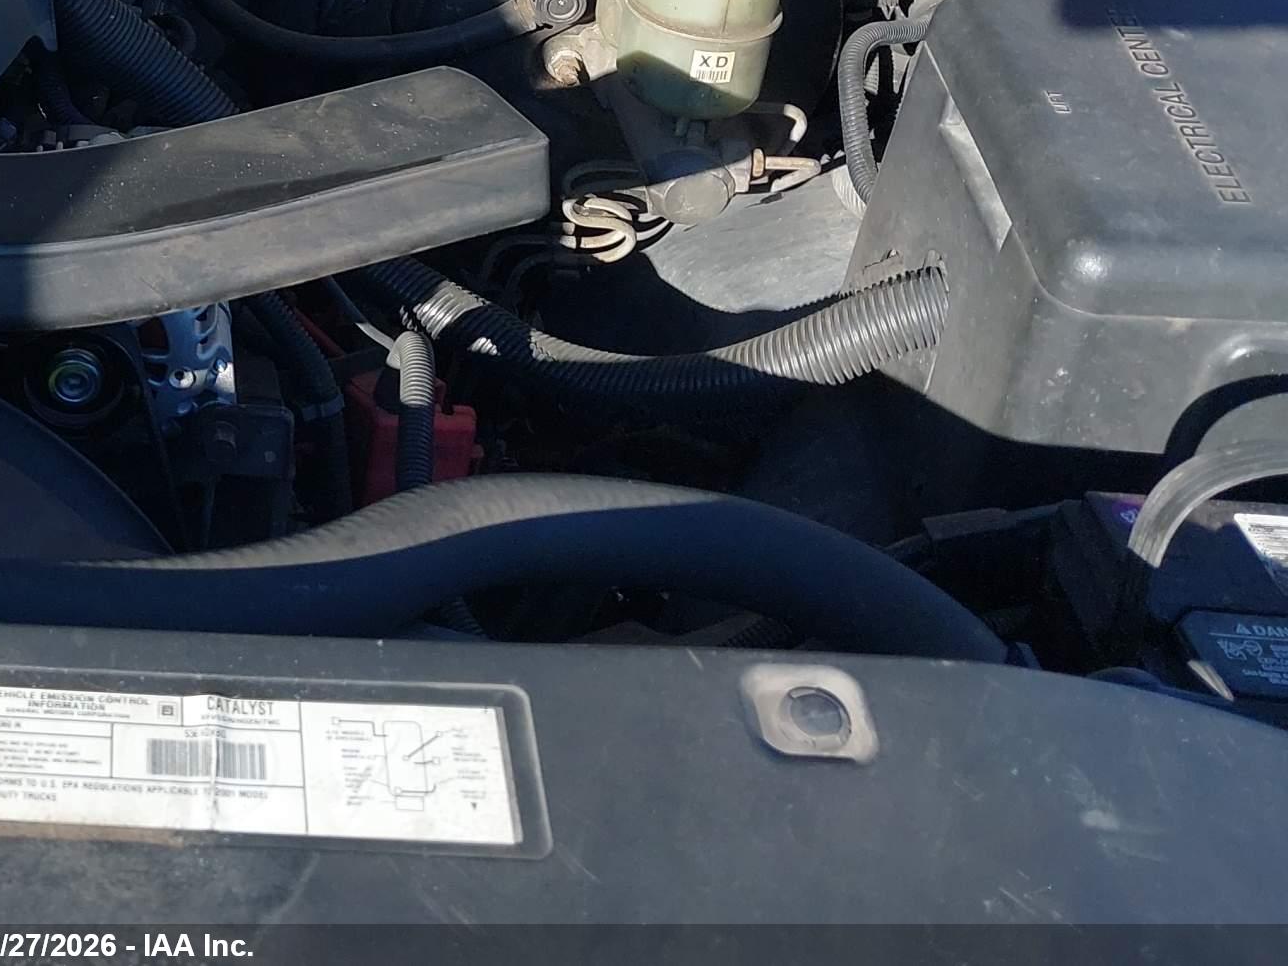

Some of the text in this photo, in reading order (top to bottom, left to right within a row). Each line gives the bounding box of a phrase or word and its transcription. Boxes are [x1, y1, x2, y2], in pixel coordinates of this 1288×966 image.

[699, 55, 728, 68] X D
[1153, 82, 1251, 202] ELECTRICAL
[28, 700, 105, 711] INFORMATION
[40, 693, 94, 702] EMISSION
[98, 696, 150, 706] CONTROL
[207, 696, 274, 715] CATALYST
[24, 792, 56, 802] TRUCKS
